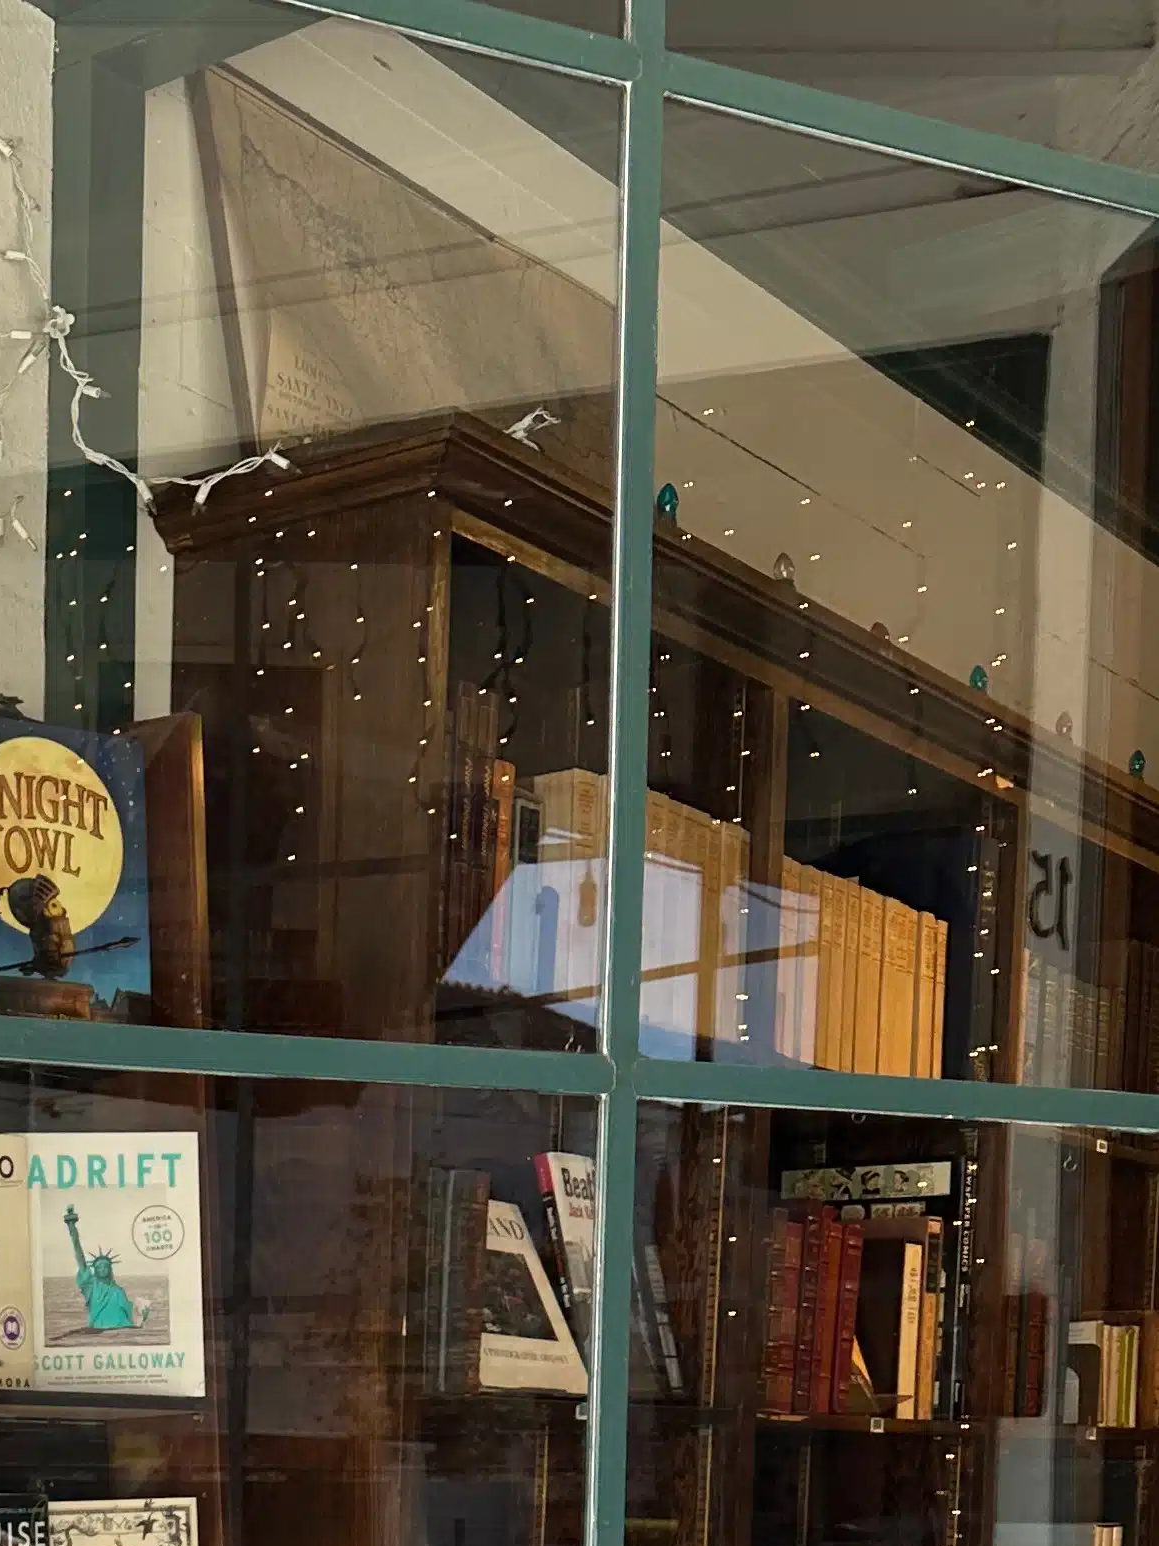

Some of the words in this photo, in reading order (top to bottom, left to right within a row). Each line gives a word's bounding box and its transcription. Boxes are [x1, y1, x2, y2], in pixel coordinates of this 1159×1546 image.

[3, 826, 81, 878] OWL
[27, 1153, 182, 1189] ADRIFT
[143, 1230, 172, 1244] 100
